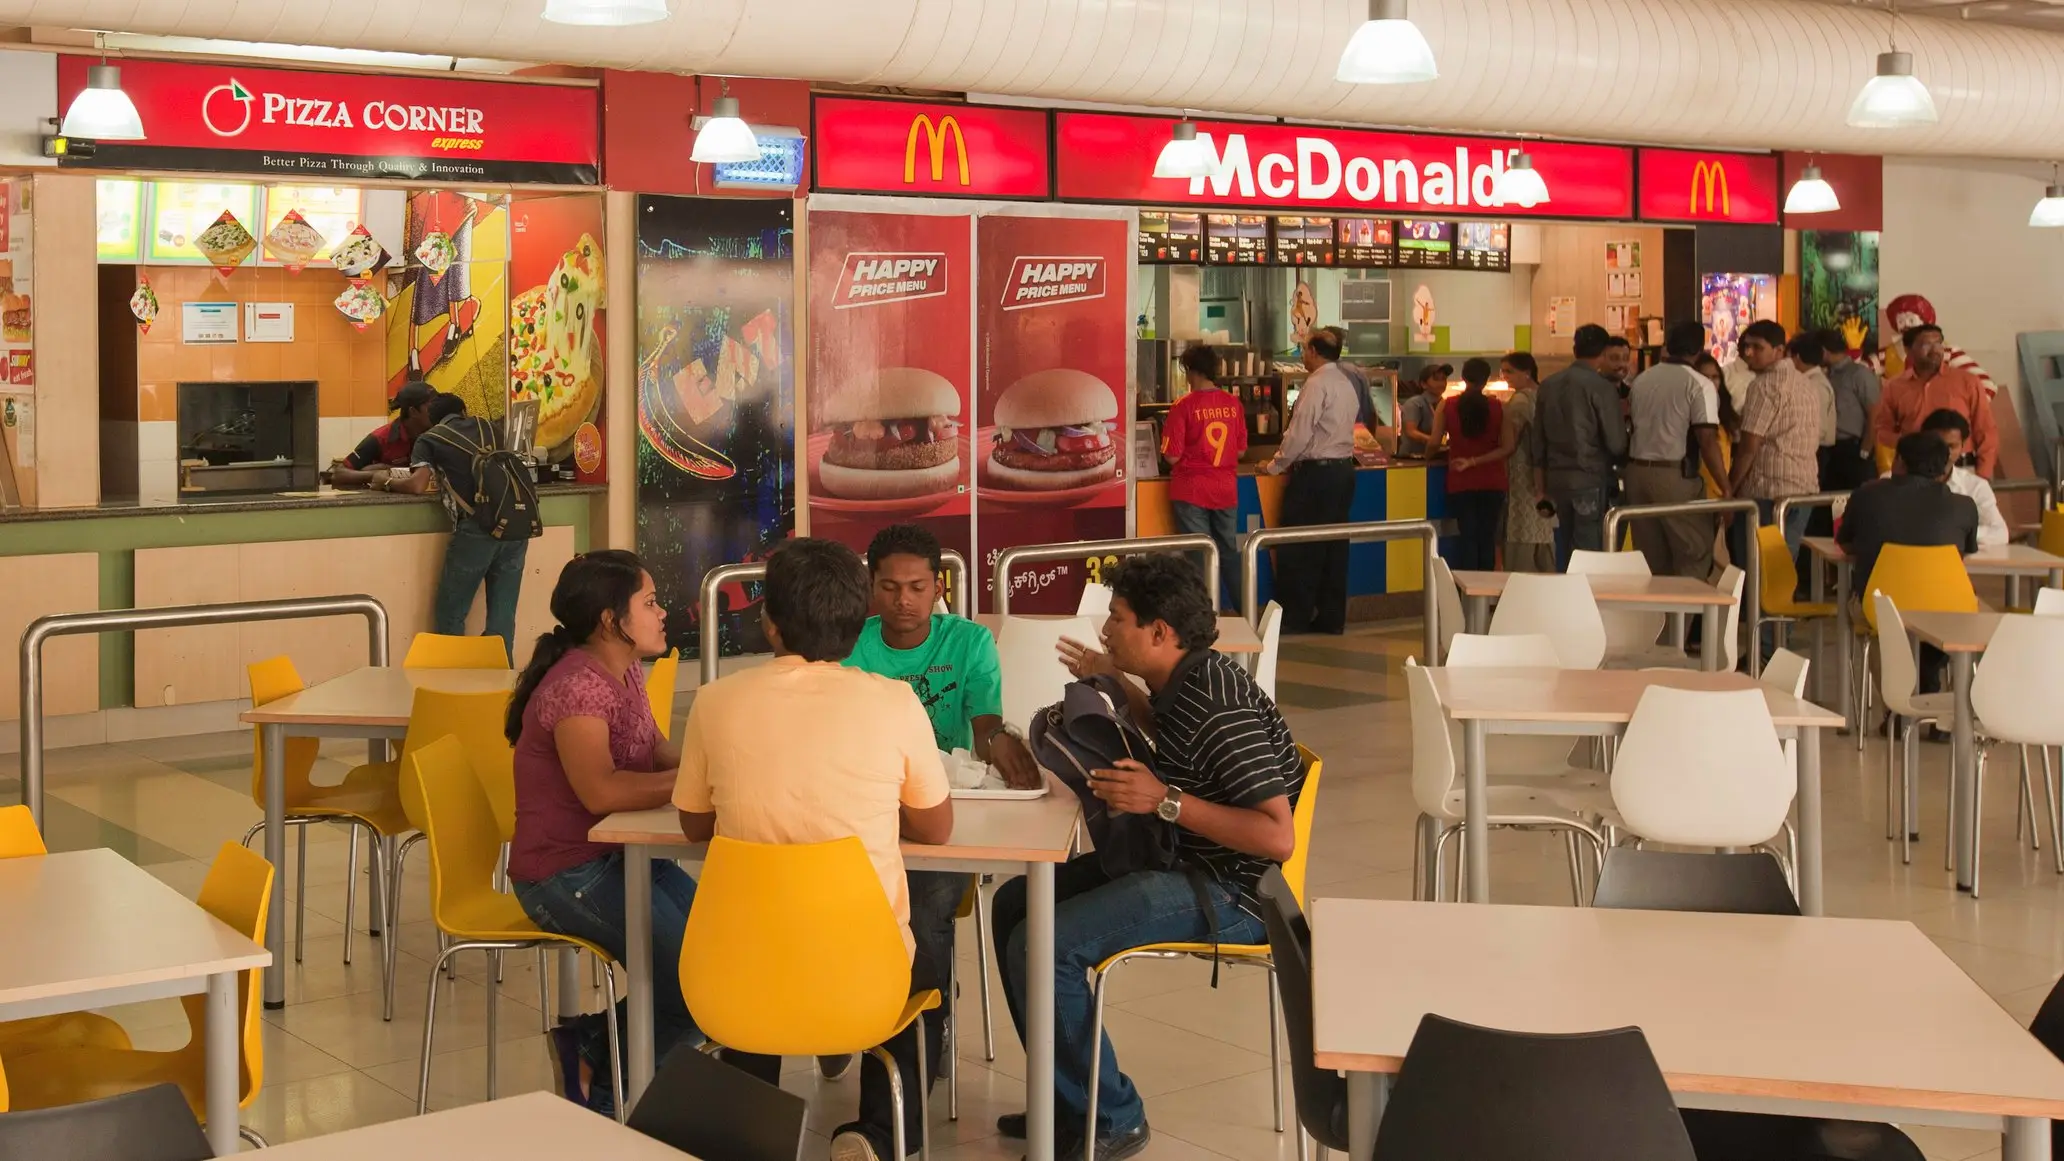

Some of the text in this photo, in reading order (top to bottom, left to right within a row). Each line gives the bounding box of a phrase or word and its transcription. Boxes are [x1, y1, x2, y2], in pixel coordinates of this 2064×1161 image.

[262, 93, 484, 134] PIZZA CORNER
[431, 136, 484, 150] express
[263, 156, 485, 174] Better Pizza Through Quality & Innovation
[853, 259, 938, 281] HAPPY
[1020, 262, 1098, 284] HAPPY
[848, 280, 927, 299] PRICE MENU
[1016, 283, 1087, 301] PRICE MENU
[1195, 407, 1237, 421] TORRES
[1205, 421, 1228, 468] 9
[928, 664, 953, 674] SHOW
